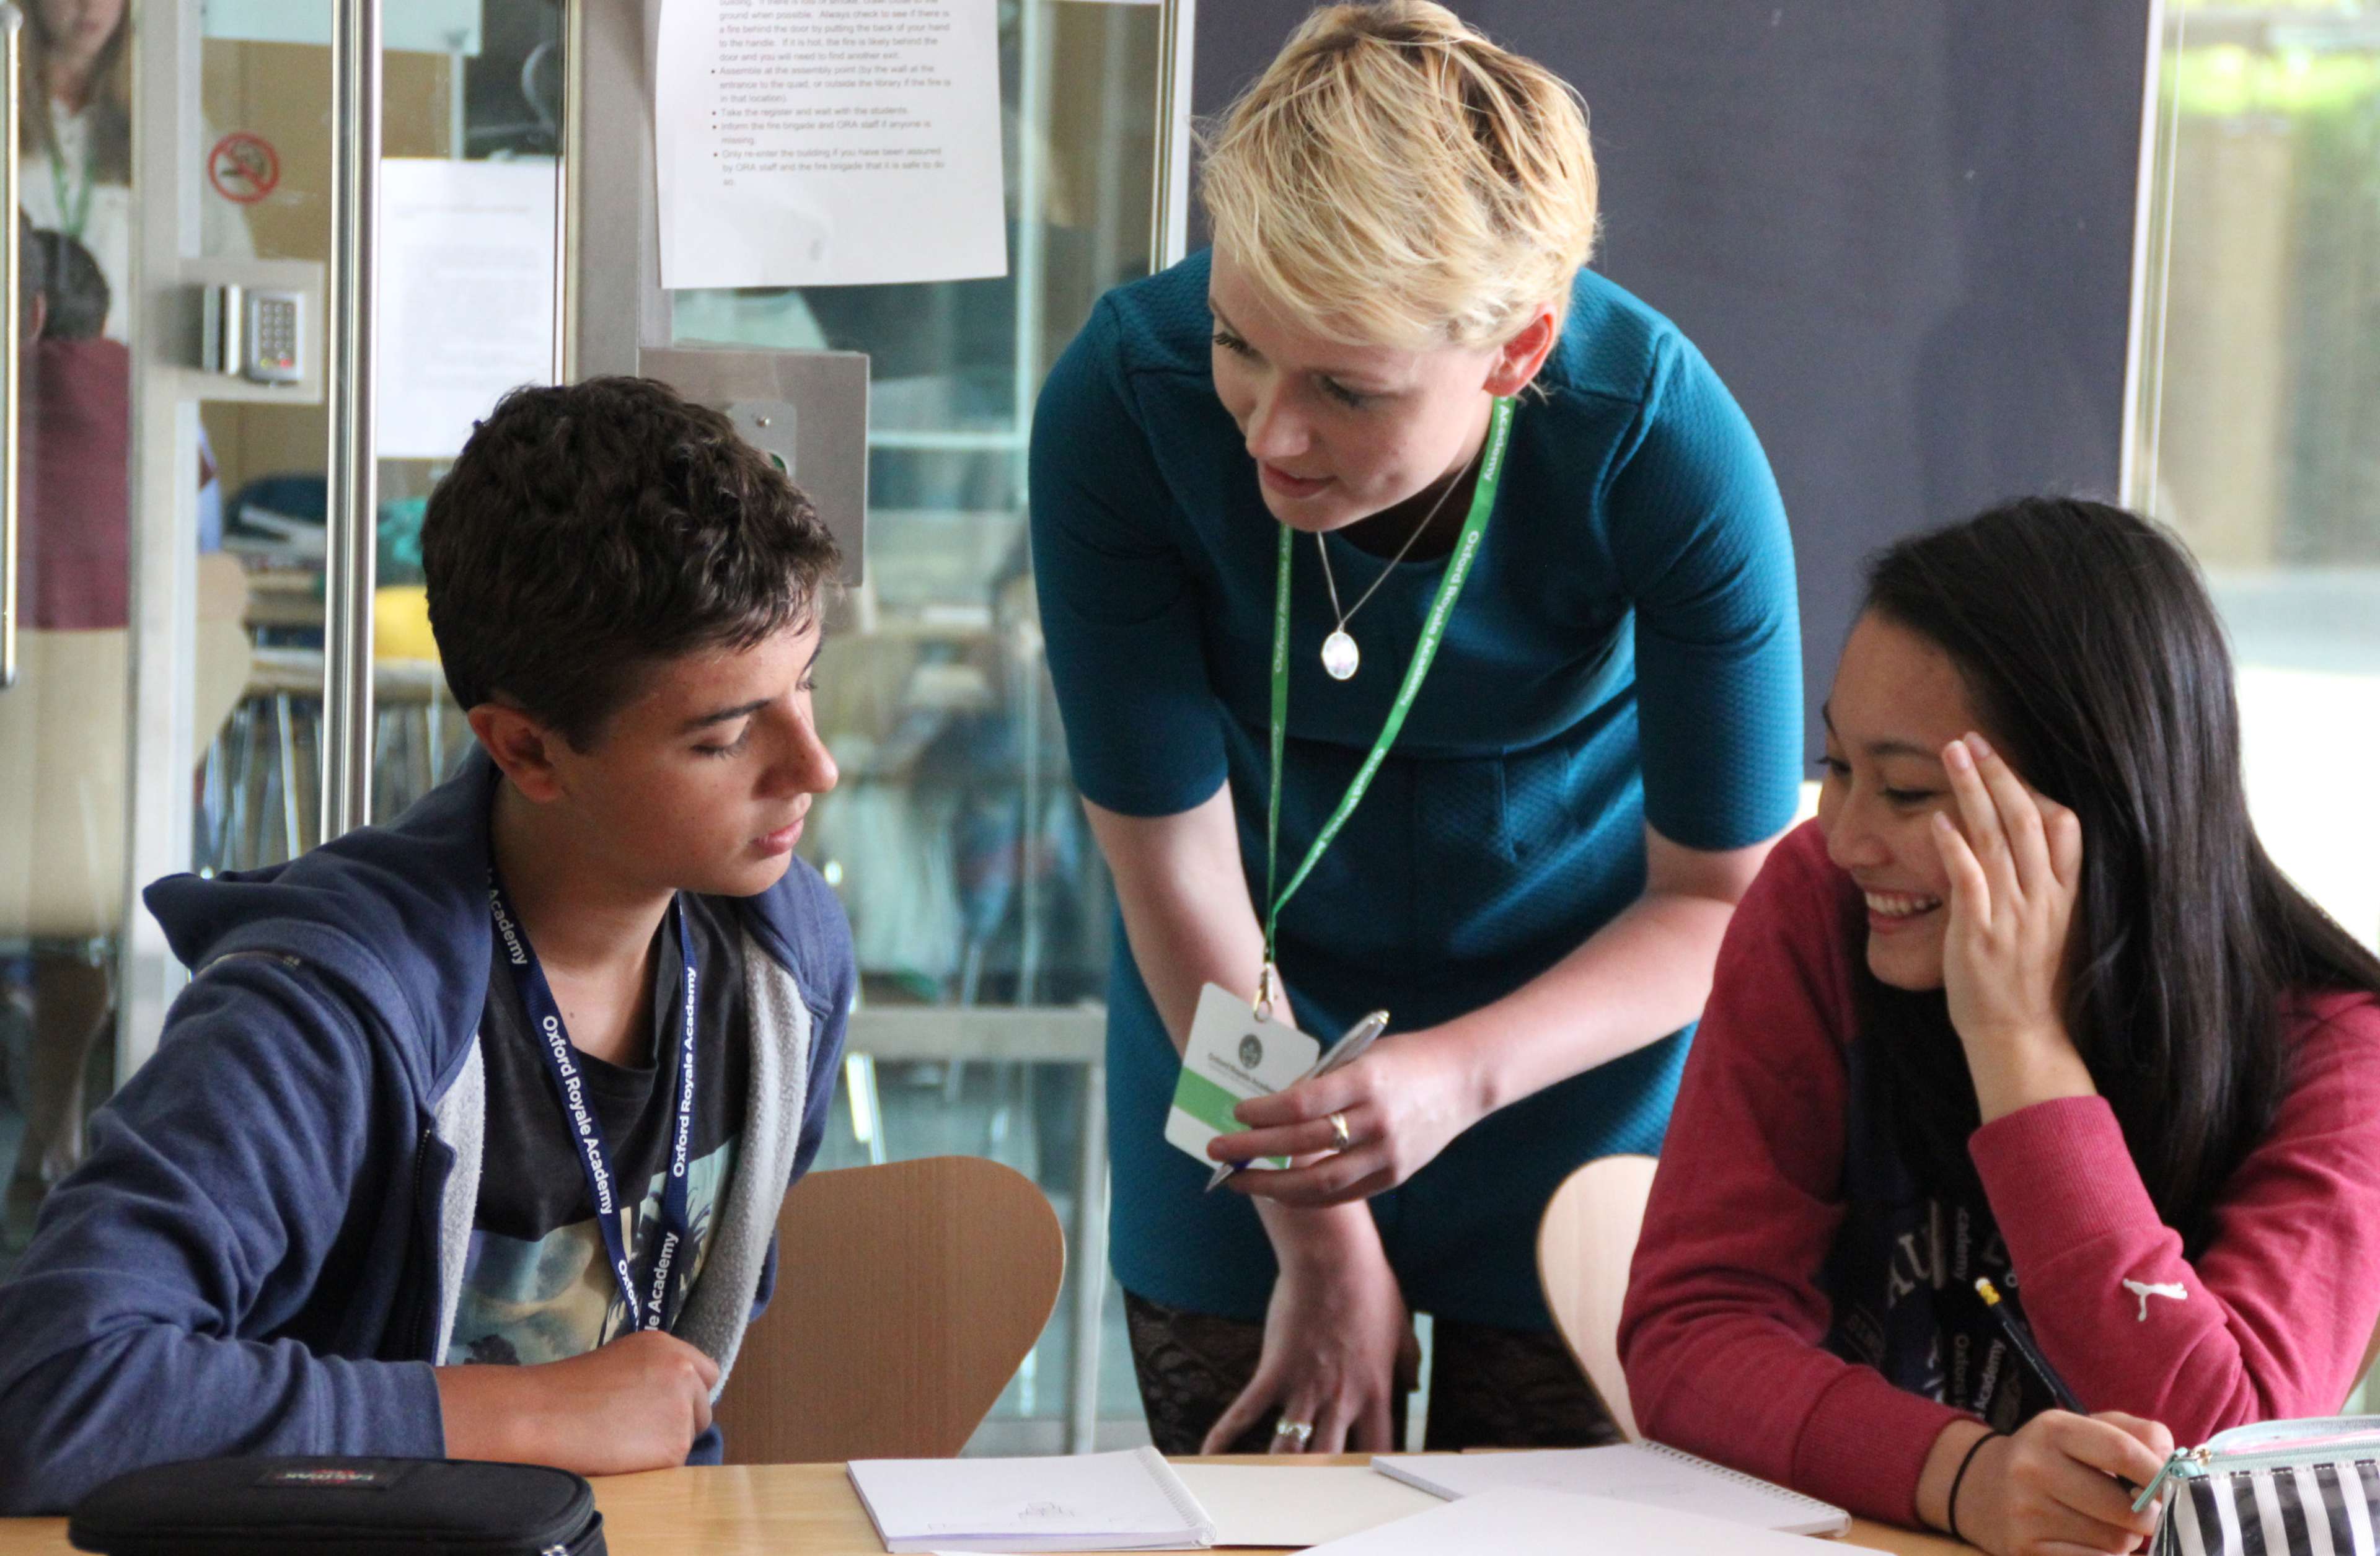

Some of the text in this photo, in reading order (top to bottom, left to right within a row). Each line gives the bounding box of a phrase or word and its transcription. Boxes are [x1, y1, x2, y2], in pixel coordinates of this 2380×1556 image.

[1484, 405, 1510, 481] Academy
[1450, 530, 1479, 584] Oxford
[1428, 586, 1457, 635] Royale
[488, 889, 528, 965] Academy
[673, 967, 696, 1177] Oxford Royale Academy
[543, 1016, 612, 1215] Oxford Royale Academy
[648, 1231, 679, 1314] Academy
[1973, 1338, 2007, 1410] Academy
